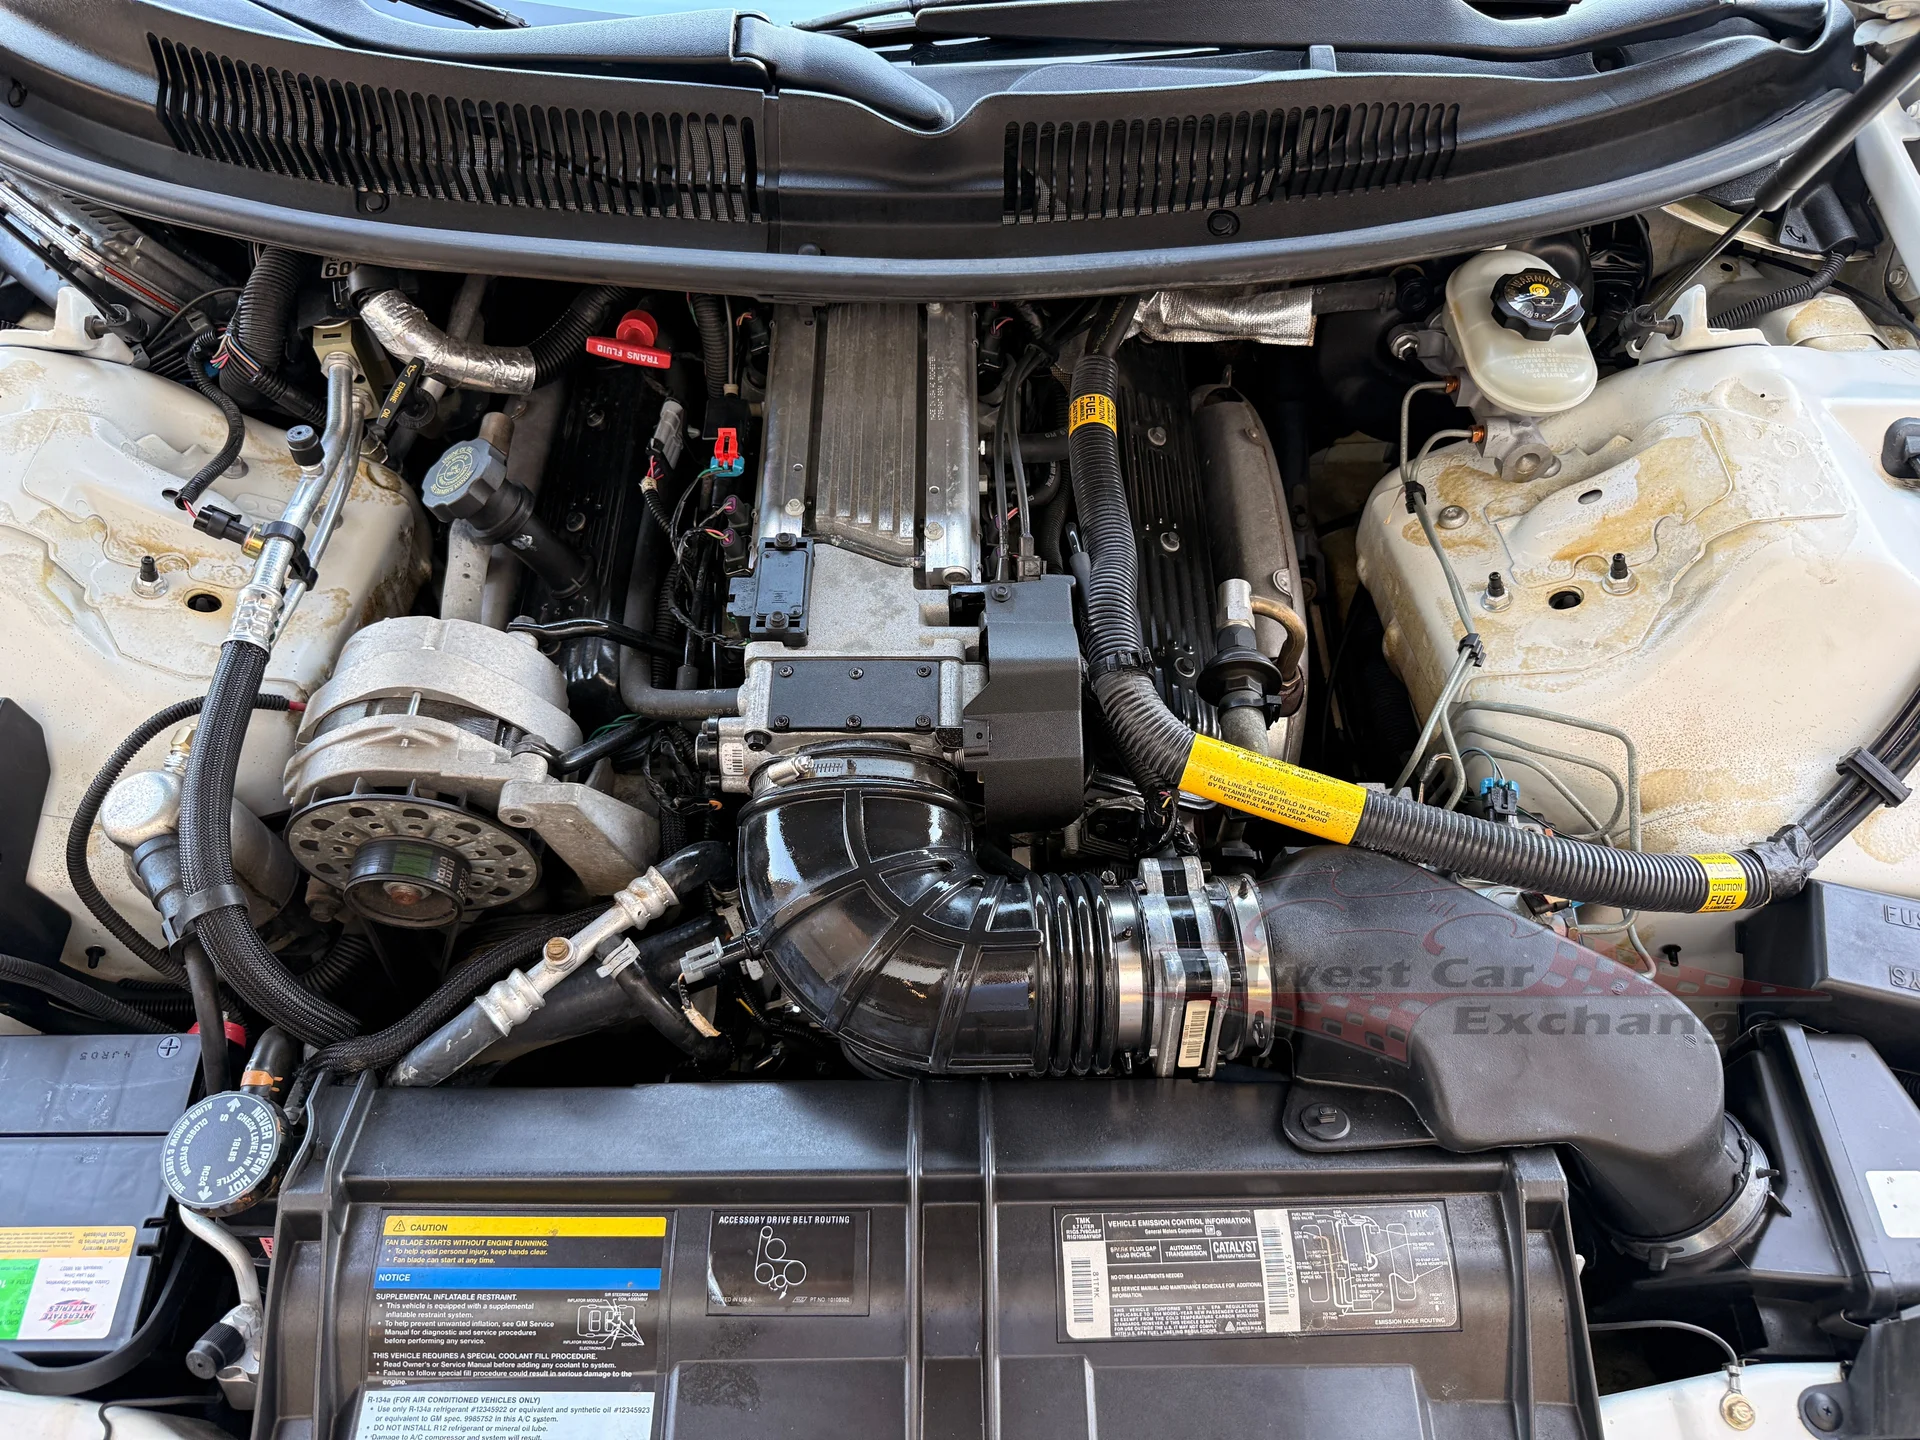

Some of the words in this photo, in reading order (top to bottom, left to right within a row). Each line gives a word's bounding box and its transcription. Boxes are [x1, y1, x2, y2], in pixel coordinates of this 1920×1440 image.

[1514, 275, 1561, 288] WARNING
[597, 345, 622, 357] FLUID
[627, 351, 658, 364] TRANS
[390, 381, 406, 404] ENGINE
[381, 408, 391, 420] OIL
[1086, 396, 1095, 419] FUEL
[1274, 766, 1289, 774] FIRE
[1291, 771, 1319, 783] HAZARD
[1209, 775, 1226, 785] FUEL
[1227, 781, 1247, 791] LINES
[1248, 787, 1267, 797] MUST
[1269, 793, 1279, 801] BE
[1279, 796, 1298, 807] HELD
[1308, 806, 1331, 818] PLACE
[1256, 783, 1287, 796] CAUTION
[1218, 785, 1252, 799] RETAINER
[1252, 795, 1275, 807] STRAP
[1286, 806, 1306, 816] HELP
[1306, 812, 1328, 824] AVOID
[1224, 793, 1260, 809] POTENTIAL
[1261, 805, 1277, 814] FIRE
[1278, 810, 1307, 823] HAZARD
[1708, 864, 1739, 872] FUEL
[1709, 895, 1736, 905] FUEL
[190, 1102, 213, 1121] ALIGN
[236, 1112, 257, 1132] CHECK
[251, 1106, 273, 1140] NEVER
[170, 1118, 190, 1146] ARROW
[183, 1118, 209, 1145] CLOSED
[249, 1131, 259, 1155] LEVEL
[165, 1156, 176, 1176] VENT
[179, 1145, 192, 1177] SYSTEM
[243, 1156, 253, 1166] IN
[249, 1143, 272, 1175] OPEN
[216, 1166, 245, 1187] BOTTLE
[170, 1175, 186, 1194] TUBE
[228, 1174, 252, 1196] HOT
[718, 1216, 765, 1224] ACCESSORY
[767, 1216, 790, 1224] DRIVE
[793, 1216, 812, 1224] BELT
[815, 1216, 850, 1224] ROUTING
[1407, 1210, 1428, 1218] TMK
[1108, 1220, 1136, 1228] VEHICLE
[1138, 1219, 1169, 1227] EMISSION
[1205, 1217, 1251, 1225] INFORMATION
[404, 1248, 418, 1256] help
[438, 1248, 468, 1257] personal
[469, 1248, 488, 1257] injury,
[490, 1248, 507, 1257] keep
[1212, 1240, 1257, 1253] CATALYST
[378, 1274, 410, 1282] NOTICE
[434, 1303, 465, 1311] equipped
[489, 1303, 534, 1311] supplemental
[393, 1396, 410, 1404] (FOR
[481, 1396, 516, 1404] VEHICLES
[518, 1397, 540, 1405] ONLY)
[392, 1406, 407, 1415] only
[433, 1406, 468, 1415] refrigerant
[518, 1407, 553, 1415] equivalent
[570, 1407, 601, 1415] synthetic
[448, 1425, 484, 1433] refrigerant
